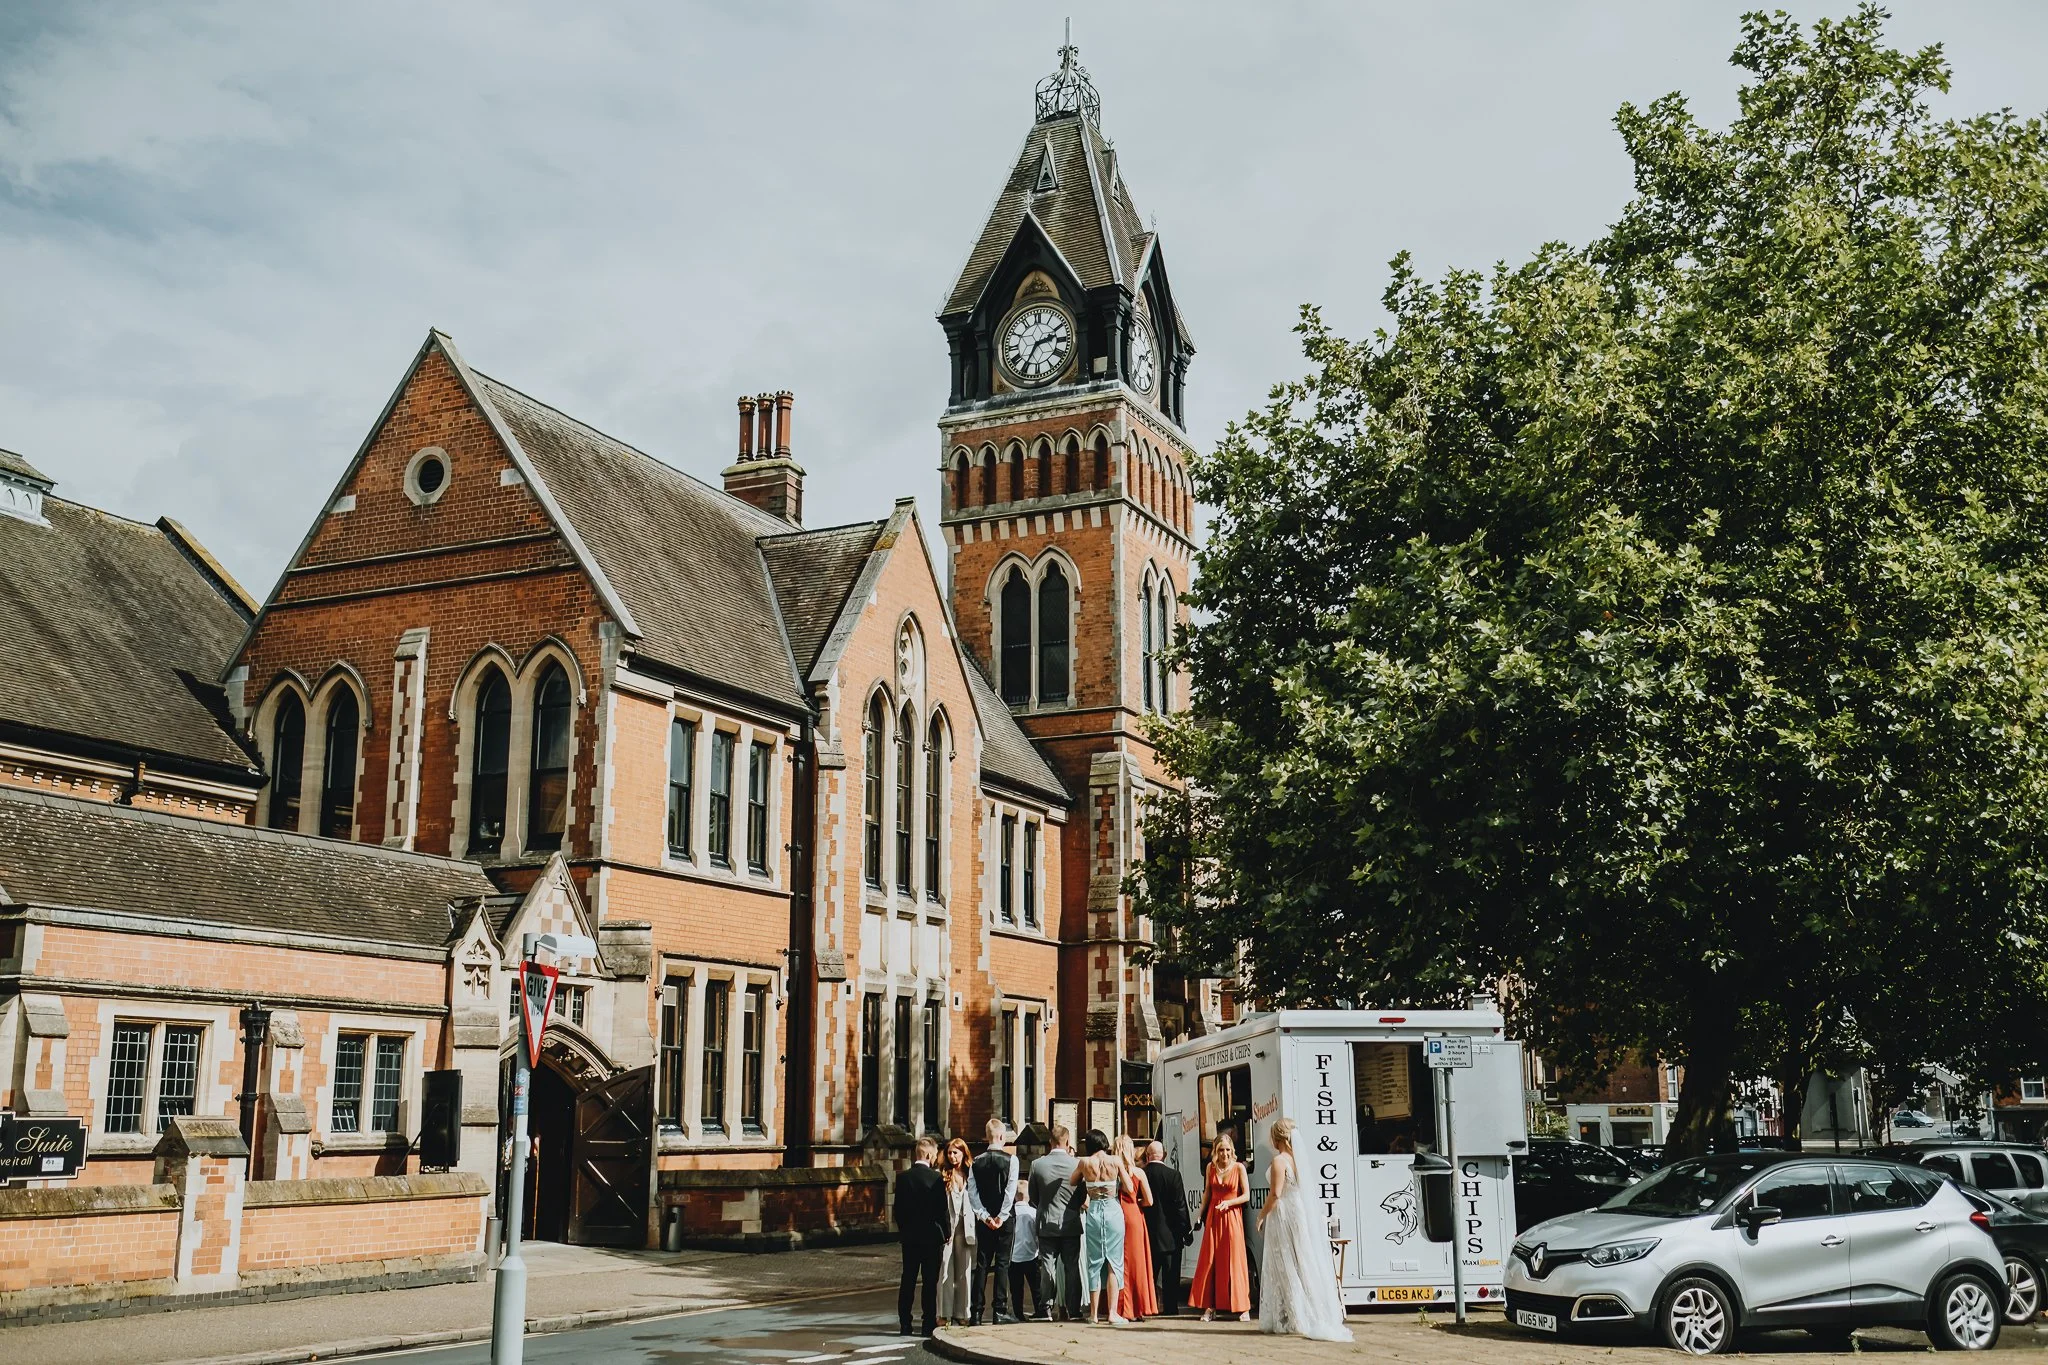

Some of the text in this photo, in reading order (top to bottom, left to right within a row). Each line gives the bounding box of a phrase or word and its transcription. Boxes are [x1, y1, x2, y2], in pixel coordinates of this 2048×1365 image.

[526, 975, 548, 999] GIVE
[1195, 1043, 1251, 1070] QUALITY FISH & CHIPS
[1315, 1054, 1338, 1125] FISH
[15, 1126, 73, 1153] Suite
[1317, 1135, 1338, 1151] &
[12, 1156, 20, 1167] it
[20, 1156, 33, 1166] all
[1460, 1161, 1483, 1254] CHIPS
[1381, 1289, 1409, 1301] LC69
[1411, 1289, 1430, 1300] AKJ
[1518, 1311, 1554, 1329] VU65 NPJ
